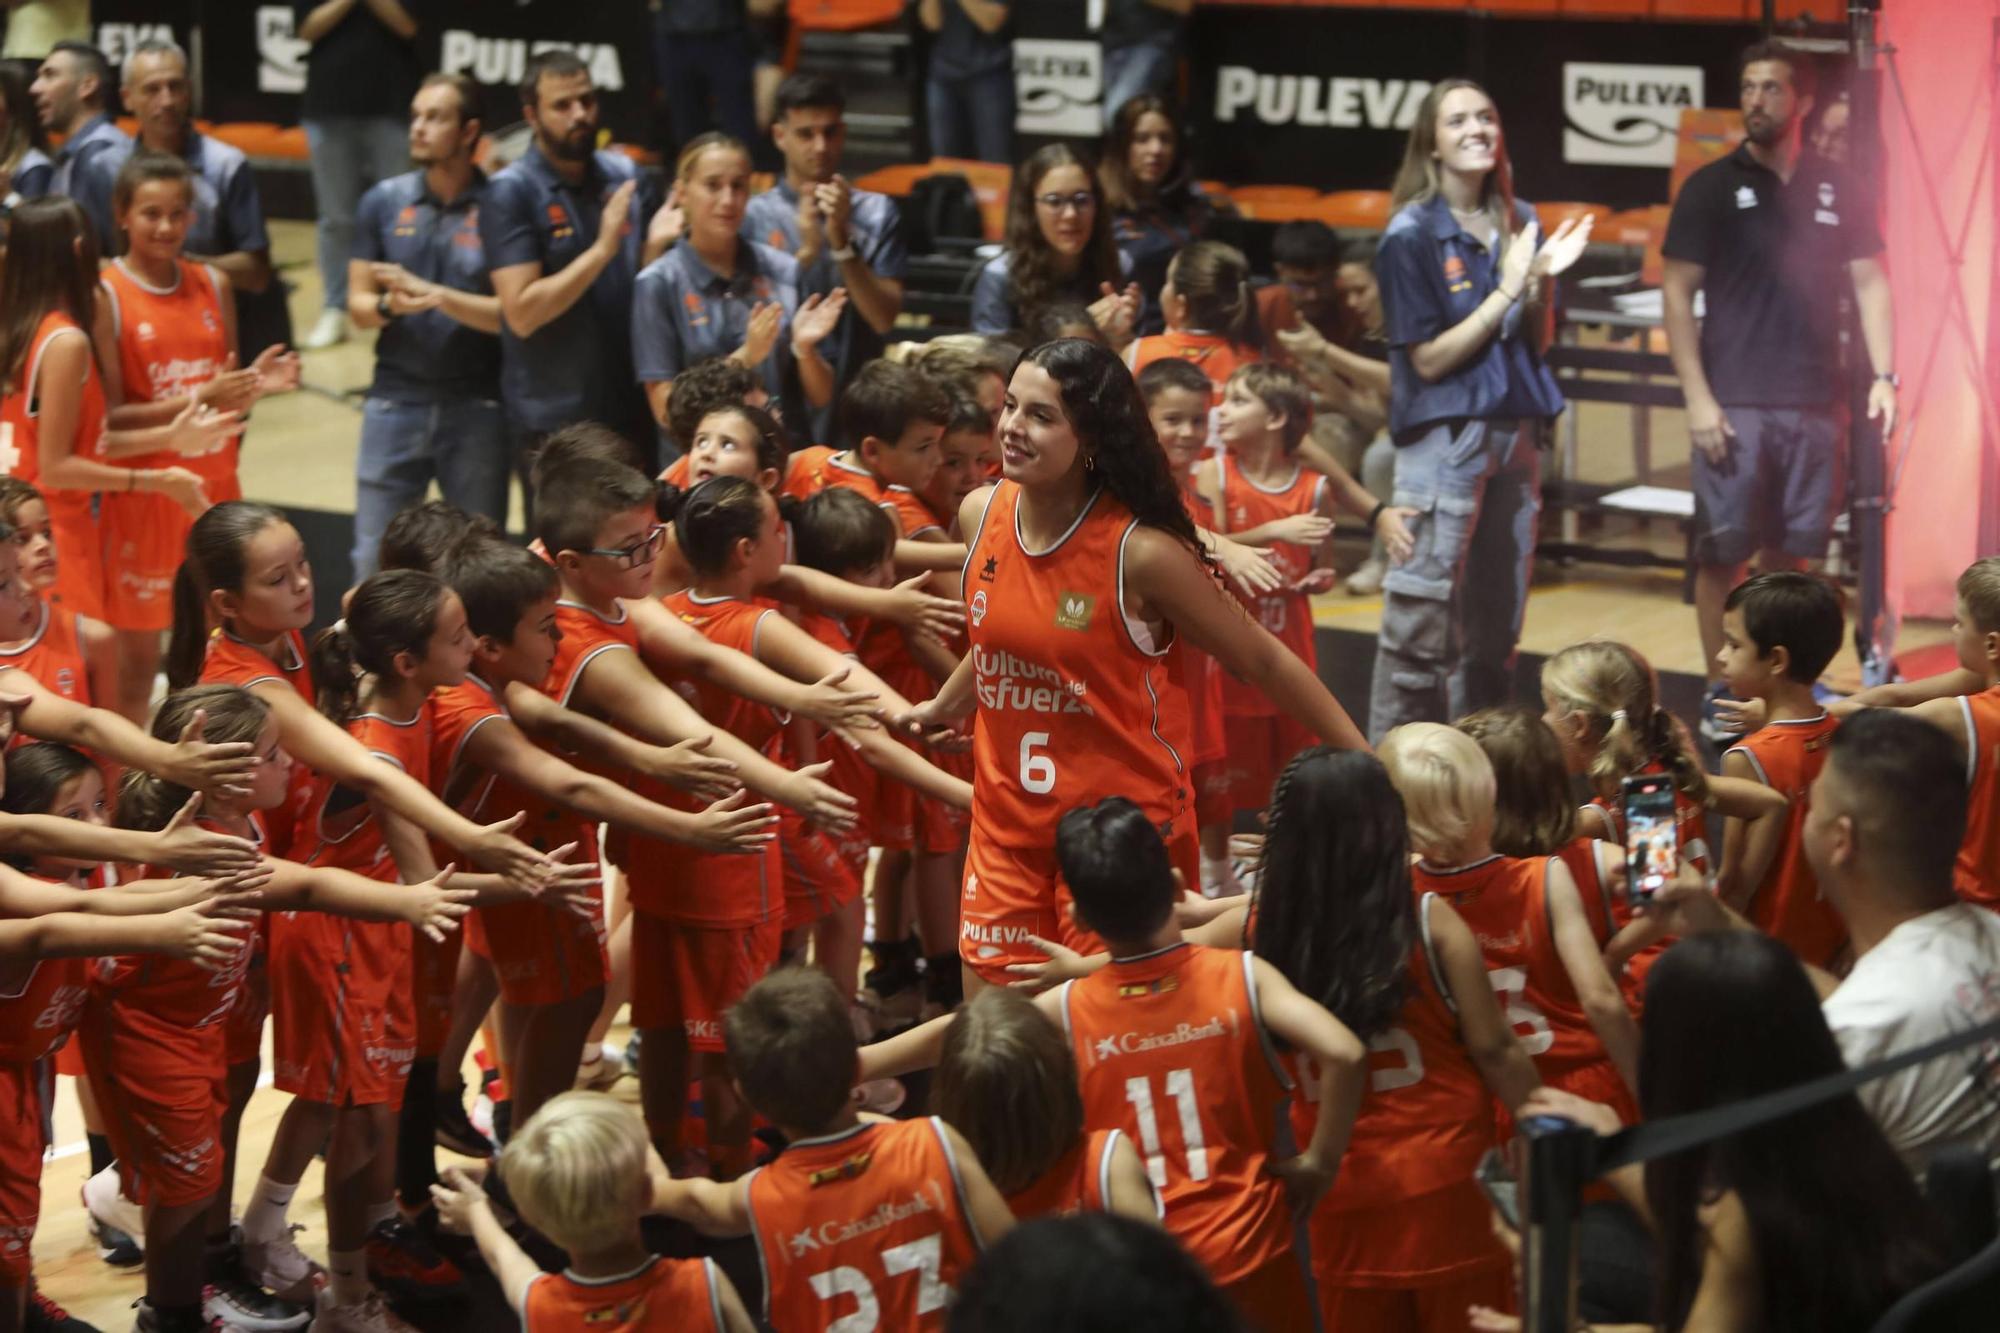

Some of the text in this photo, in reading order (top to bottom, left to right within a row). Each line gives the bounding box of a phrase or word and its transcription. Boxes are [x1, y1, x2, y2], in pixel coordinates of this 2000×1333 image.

[441, 29, 624, 91] PULA
[1575, 76, 1693, 106] PULEVA
[973, 643, 1061, 687] Cultura
[1019, 731, 1056, 794] 6
[962, 919, 1029, 945] PULEVA
[1120, 1015, 1227, 1054] CaixaBank
[1125, 1067, 1210, 1188] 11
[818, 1191, 932, 1245] CaixaBank
